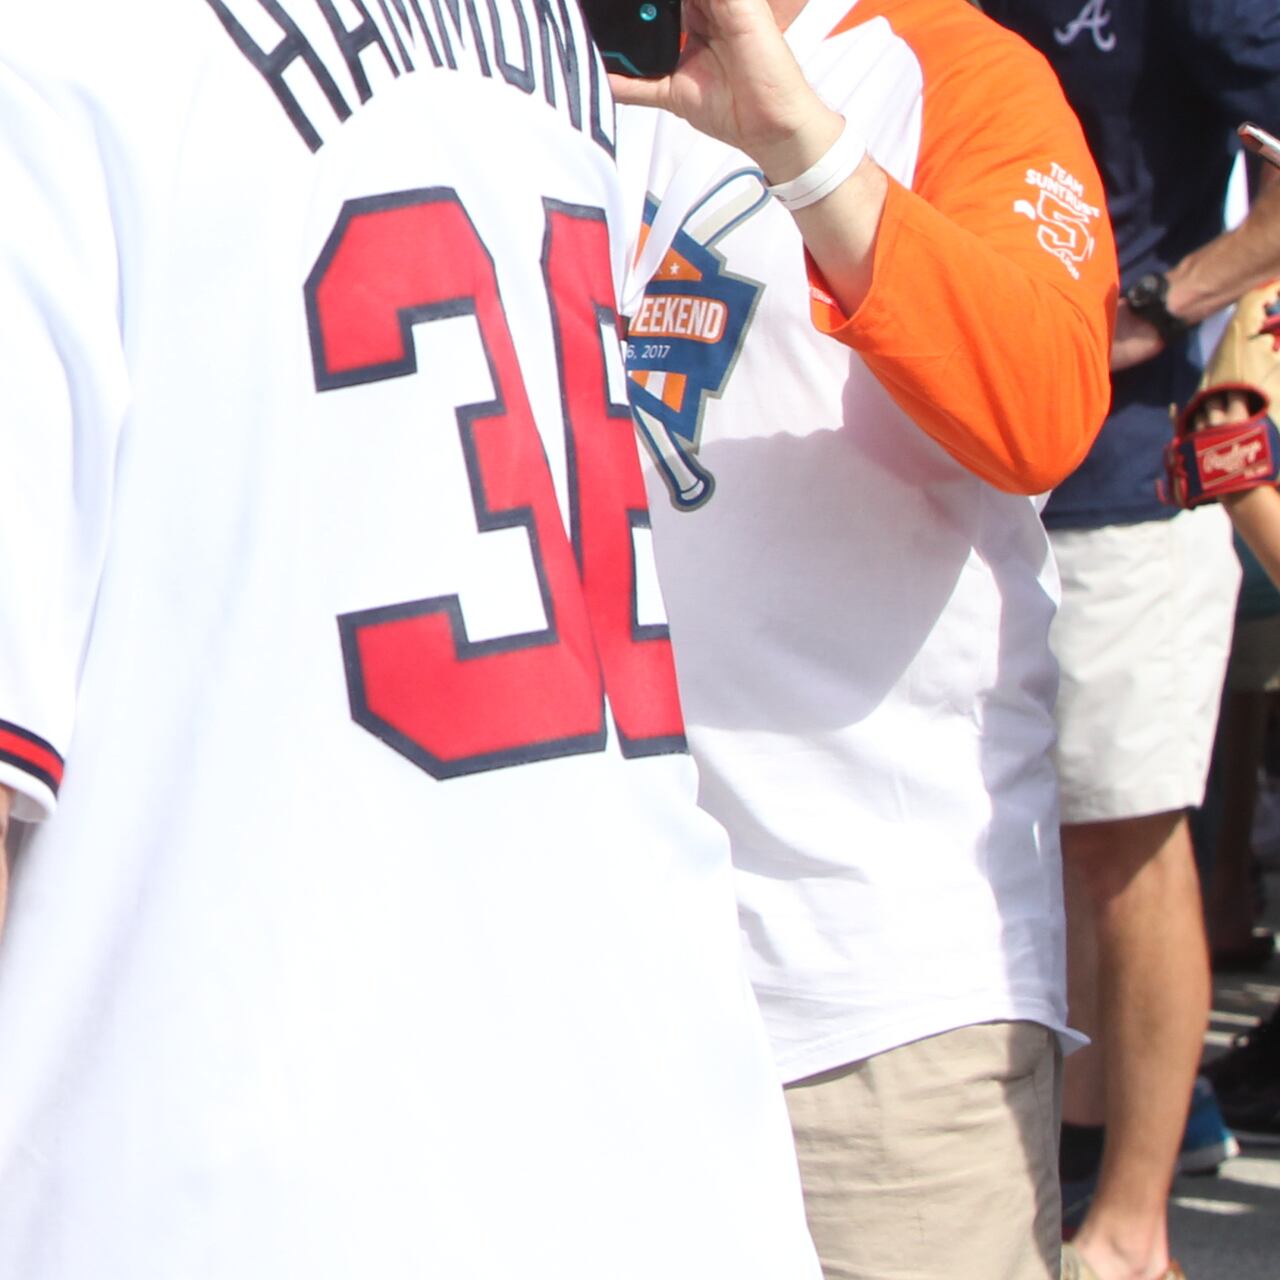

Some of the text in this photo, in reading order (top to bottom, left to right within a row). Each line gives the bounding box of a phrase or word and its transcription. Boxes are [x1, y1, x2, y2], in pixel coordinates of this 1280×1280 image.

[1025, 168, 1100, 218] SUNTRUST
[1051, 161, 1084, 198] TEAM
[640, 344, 672, 359] 2017
